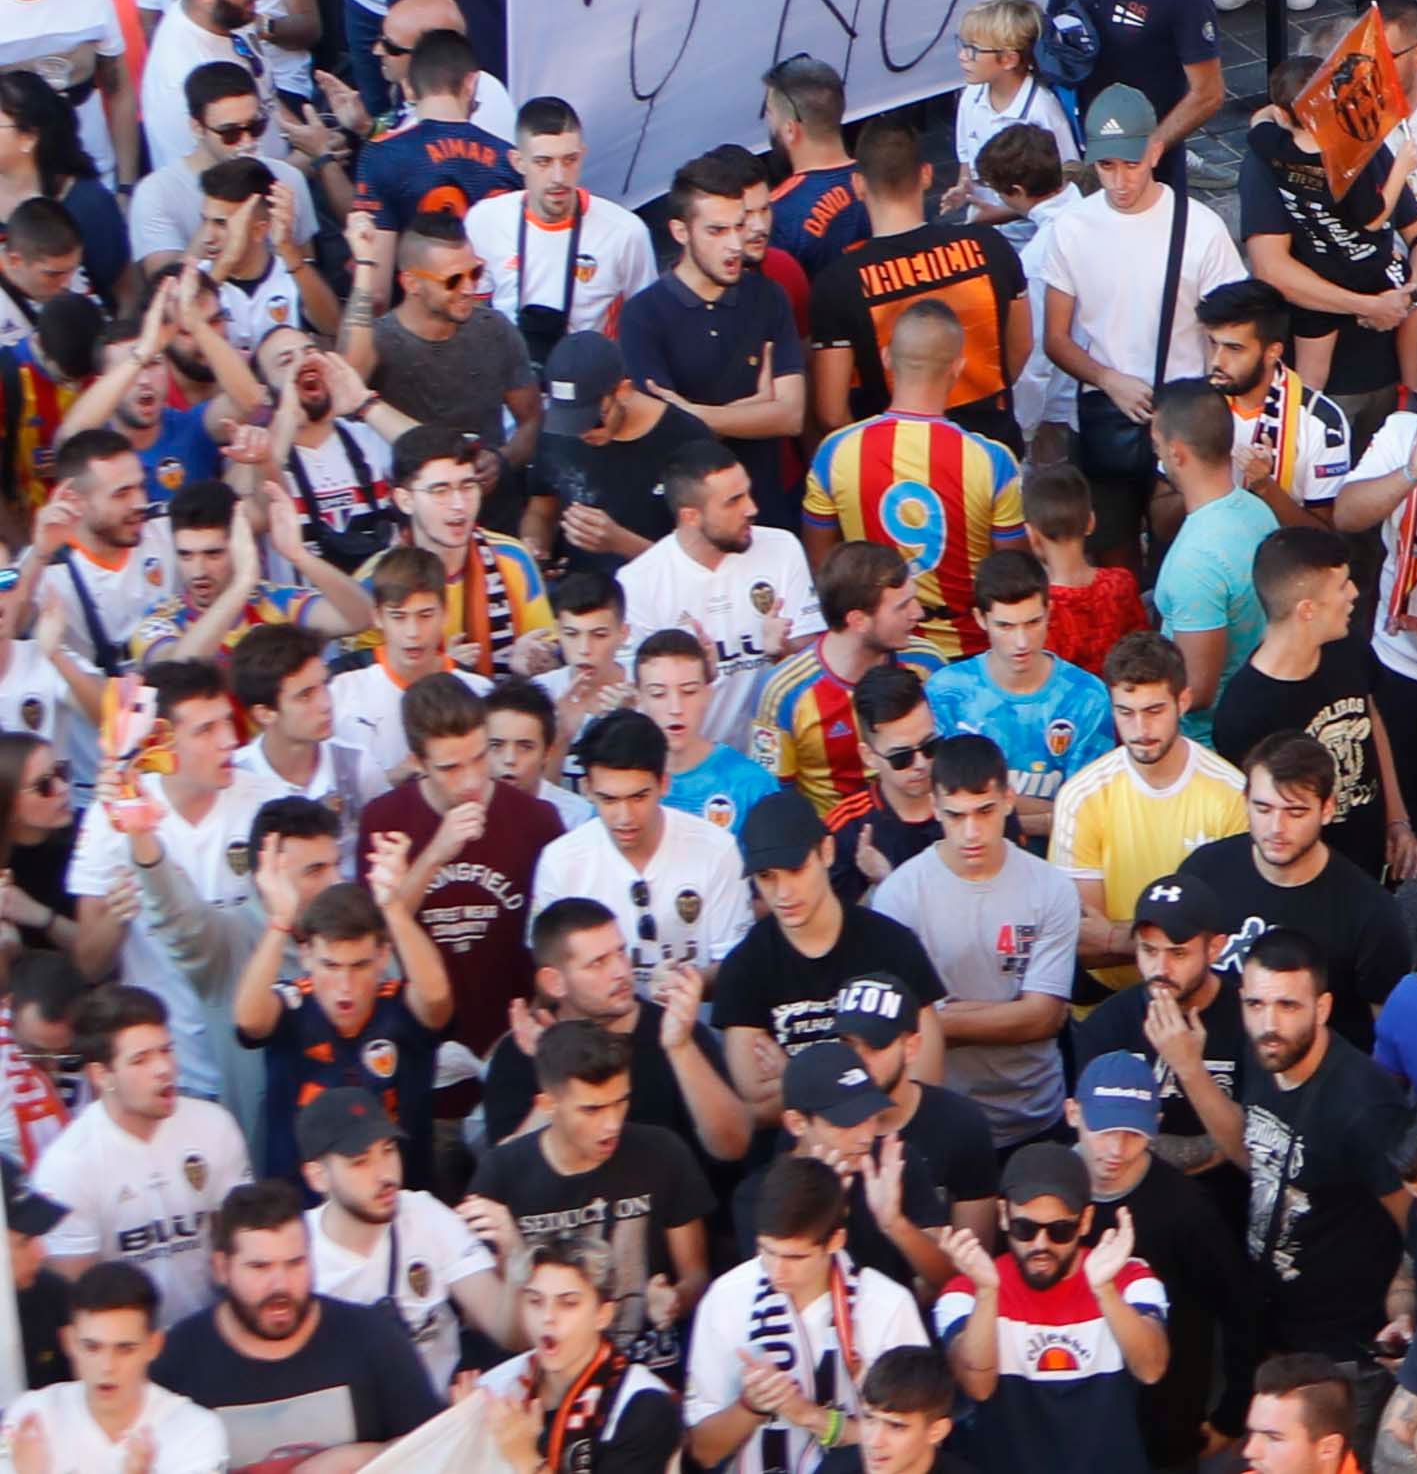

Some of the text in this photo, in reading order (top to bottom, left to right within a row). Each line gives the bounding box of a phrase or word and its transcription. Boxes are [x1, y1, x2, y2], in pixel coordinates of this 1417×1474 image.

[425, 138, 498, 167] AIMAR
[803, 184, 854, 238] DAVID
[879, 479, 948, 579] 9
[995, 923, 1017, 956] 4
[840, 985, 904, 1020] ICON
